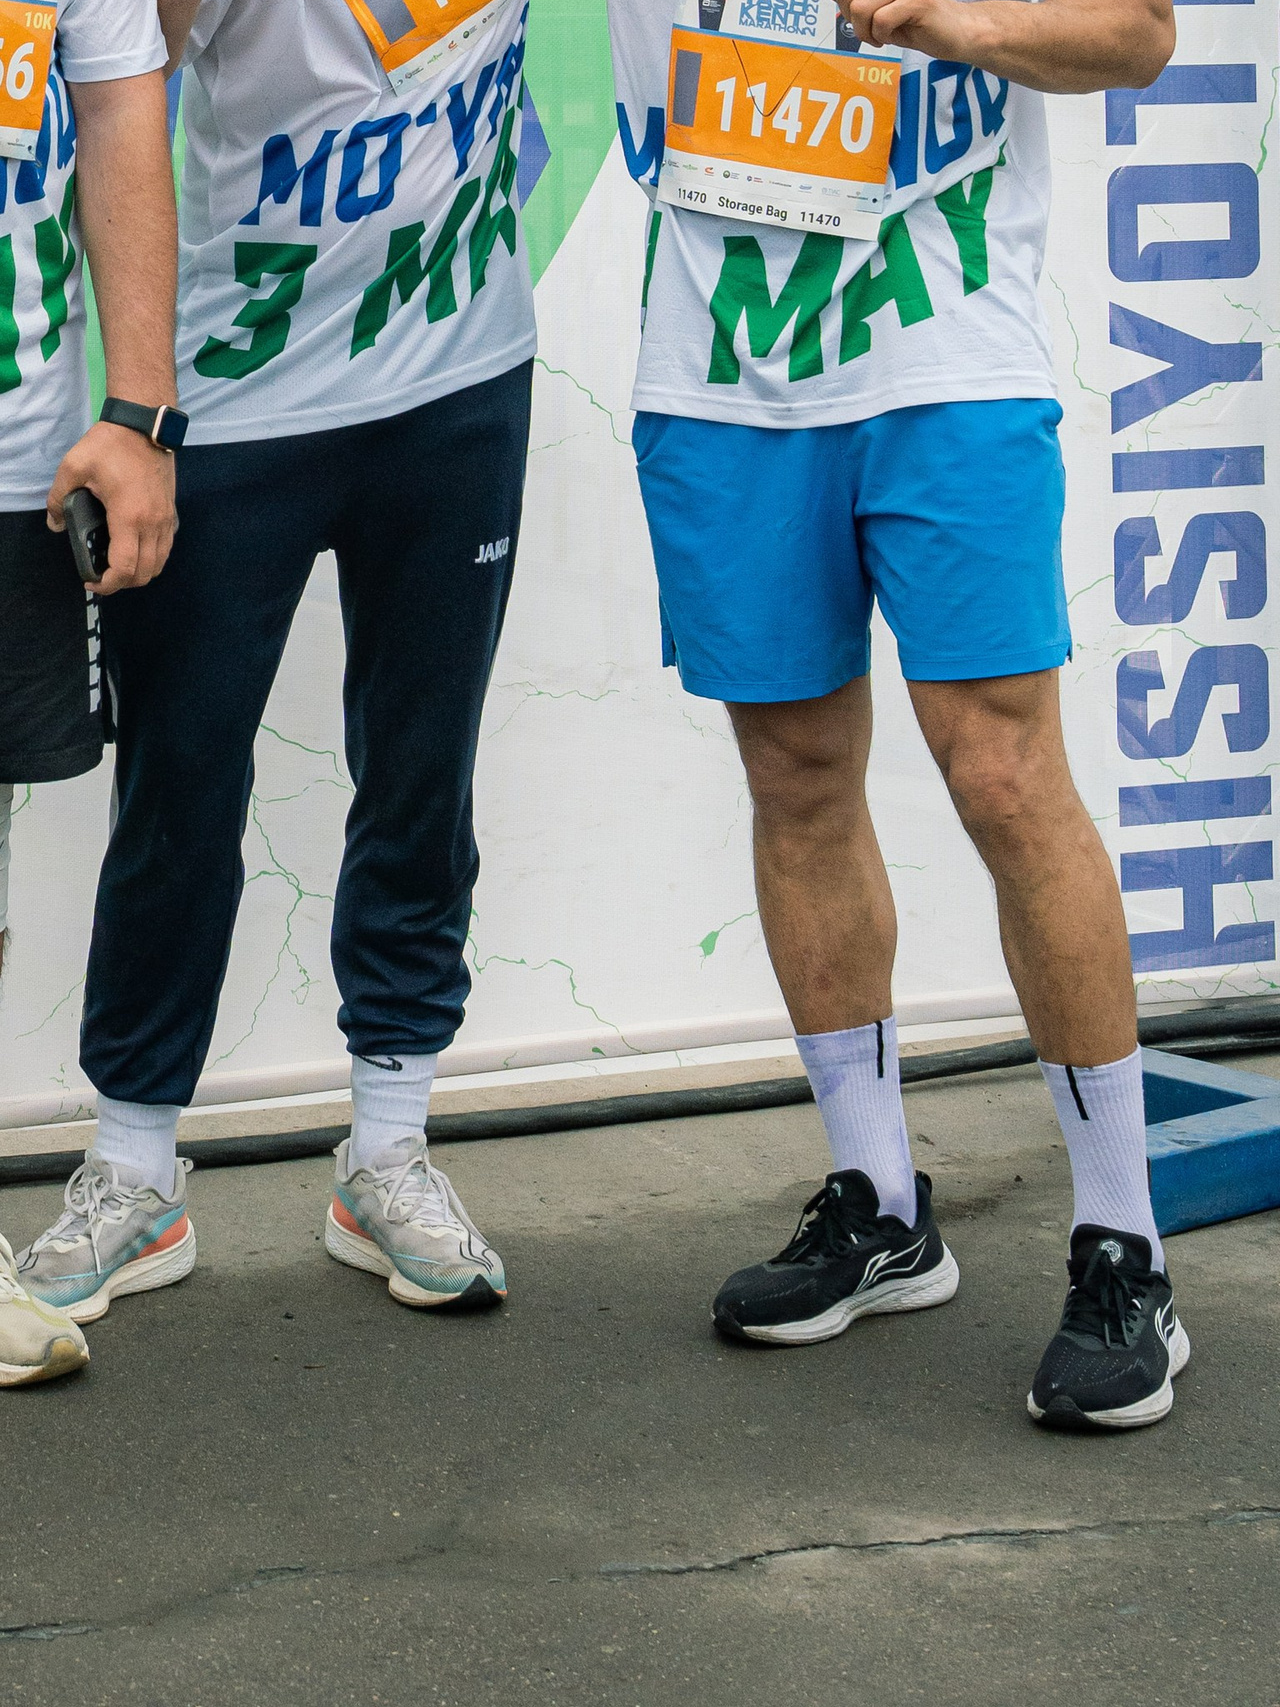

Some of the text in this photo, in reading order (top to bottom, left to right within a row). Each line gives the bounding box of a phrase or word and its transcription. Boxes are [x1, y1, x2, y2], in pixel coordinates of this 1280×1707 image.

[24, 10, 55, 31] 10K
[738, 2, 807, 30] KENT
[738, 17, 805, 36] MARATHON
[855, 64, 894, 86] 10K
[715, 76, 875, 155] 11470
[677, 187, 842, 228] 11470 Storage Bag 11470
[707, 138, 1009, 385] MAY
[193, 240, 318, 381] 3
[474, 536, 510, 564] JAKO
